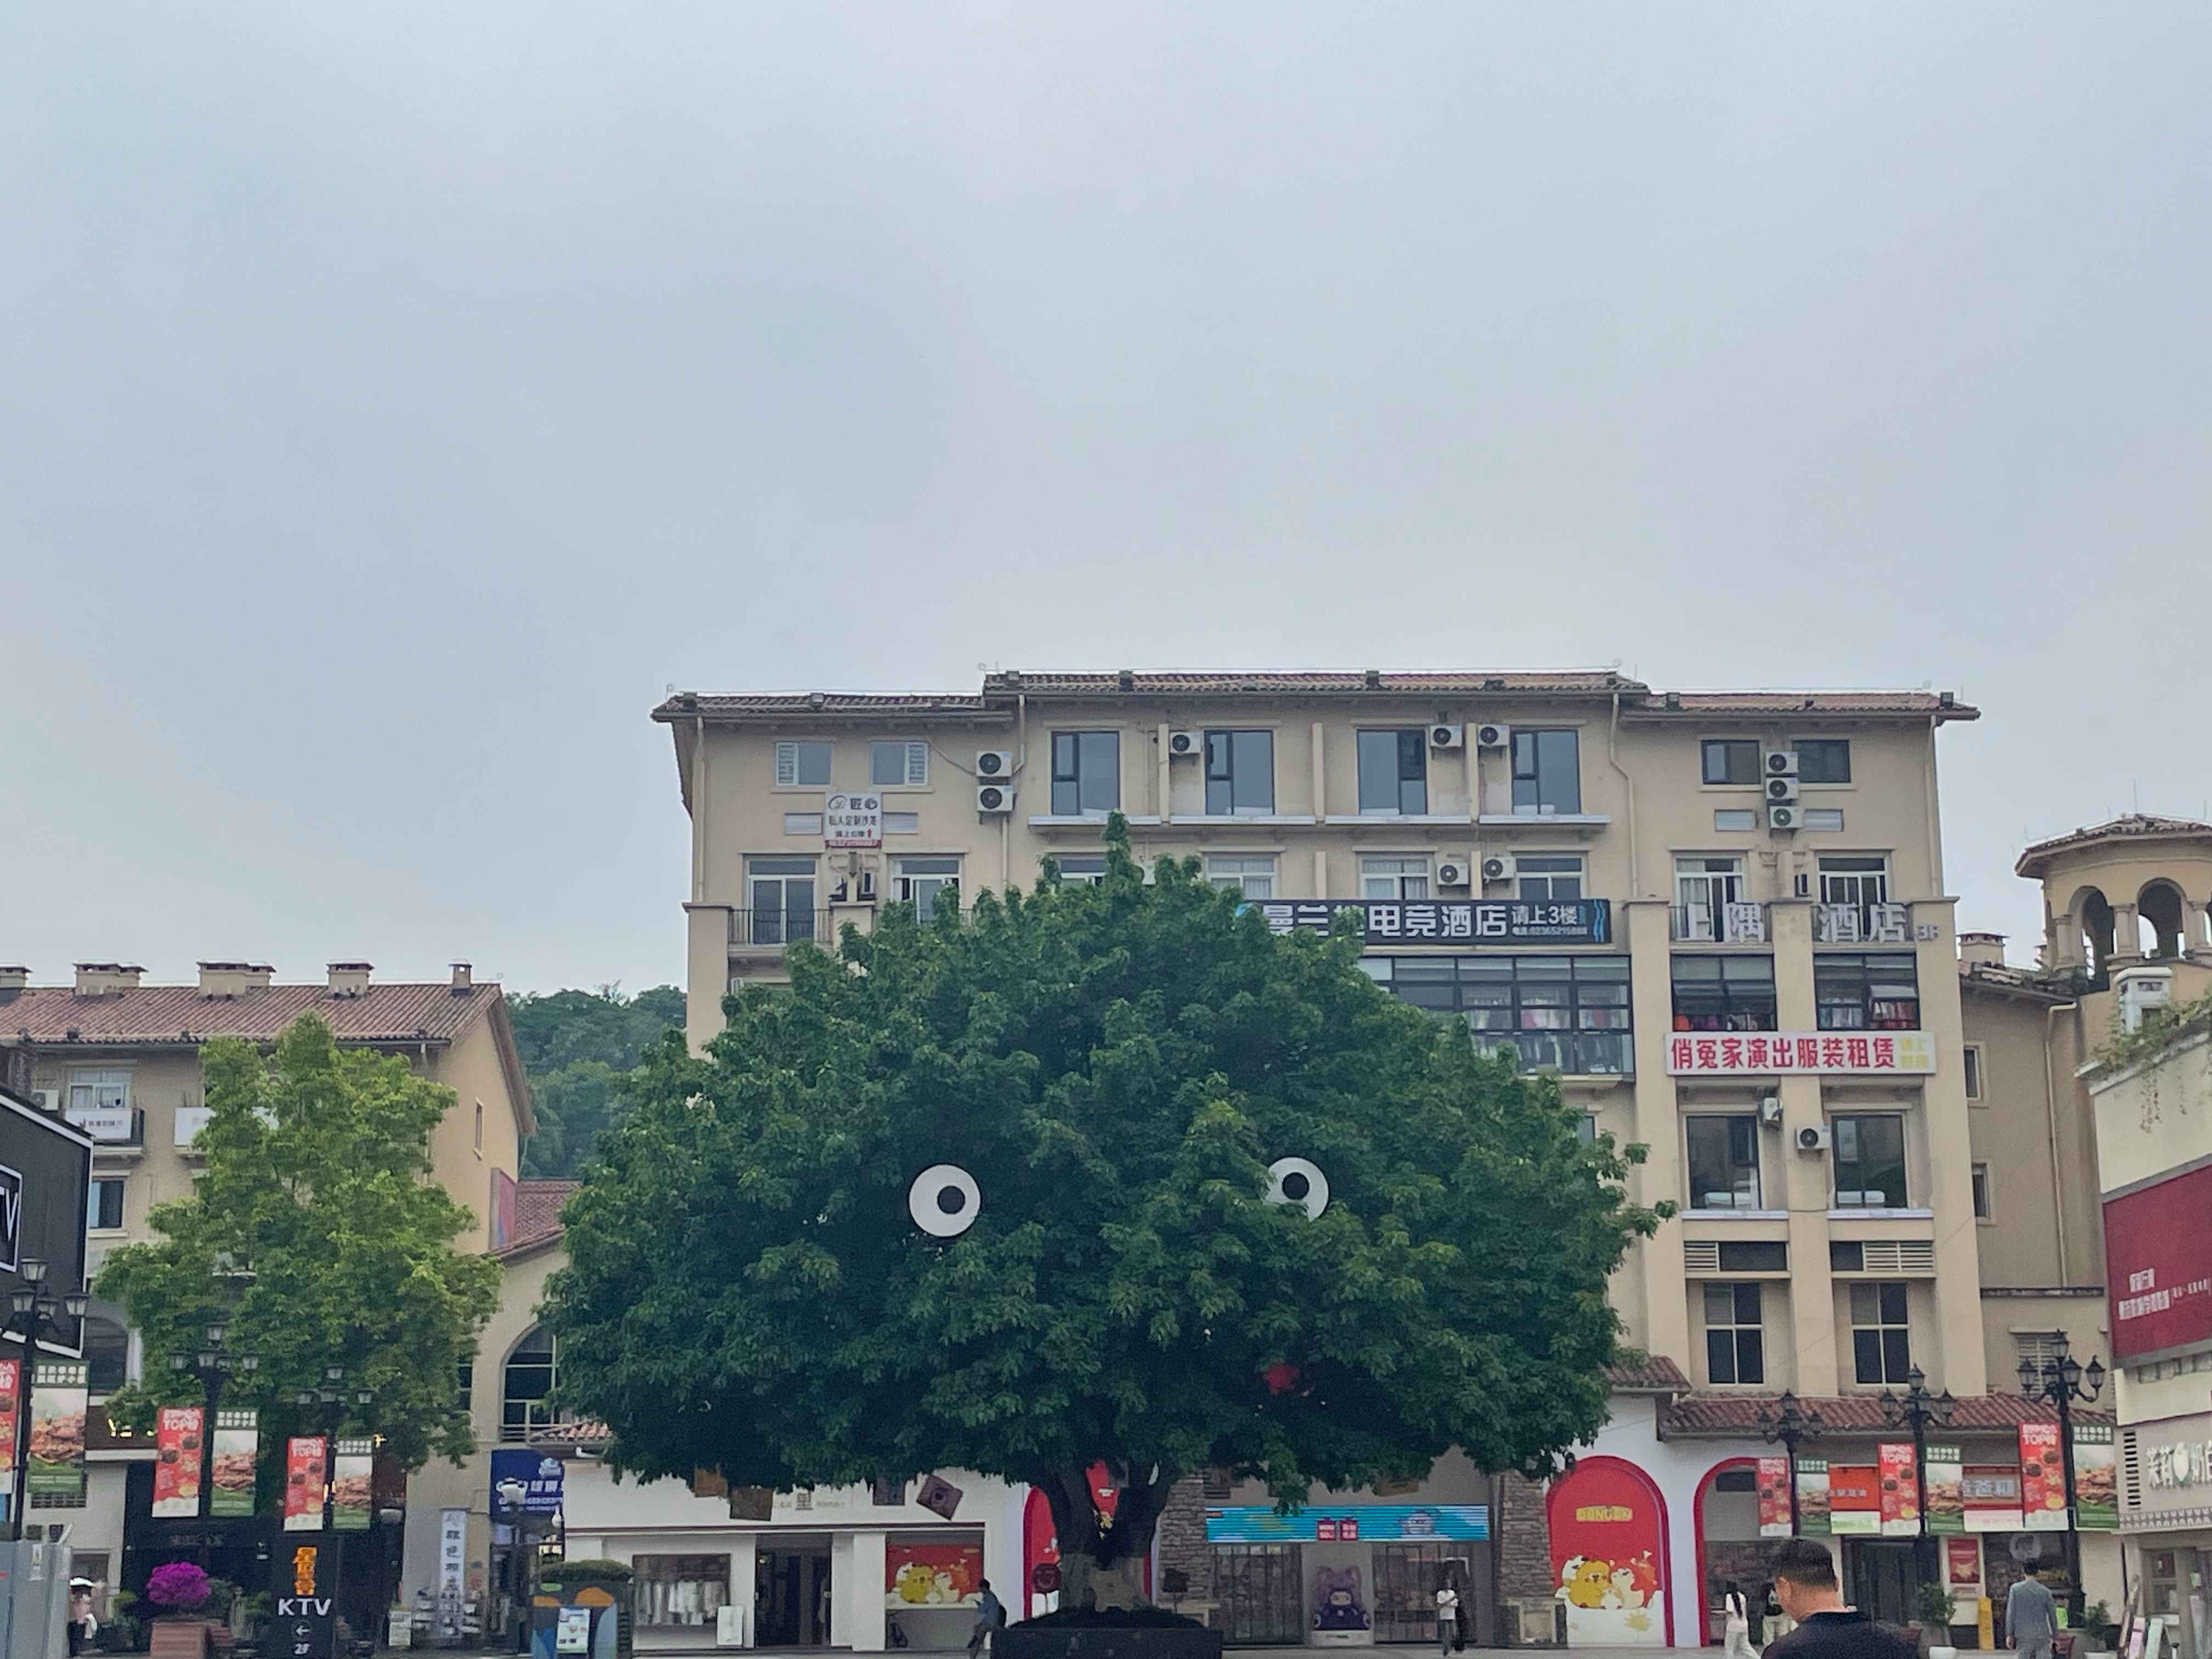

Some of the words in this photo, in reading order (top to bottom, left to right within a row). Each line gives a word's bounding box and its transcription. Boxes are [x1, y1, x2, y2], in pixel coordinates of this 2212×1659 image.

[1263, 904, 1507, 937] 曼兰电竞酒店
[1511, 905, 1578, 926] 请上3楼
[278, 1598, 331, 1616] KTV
